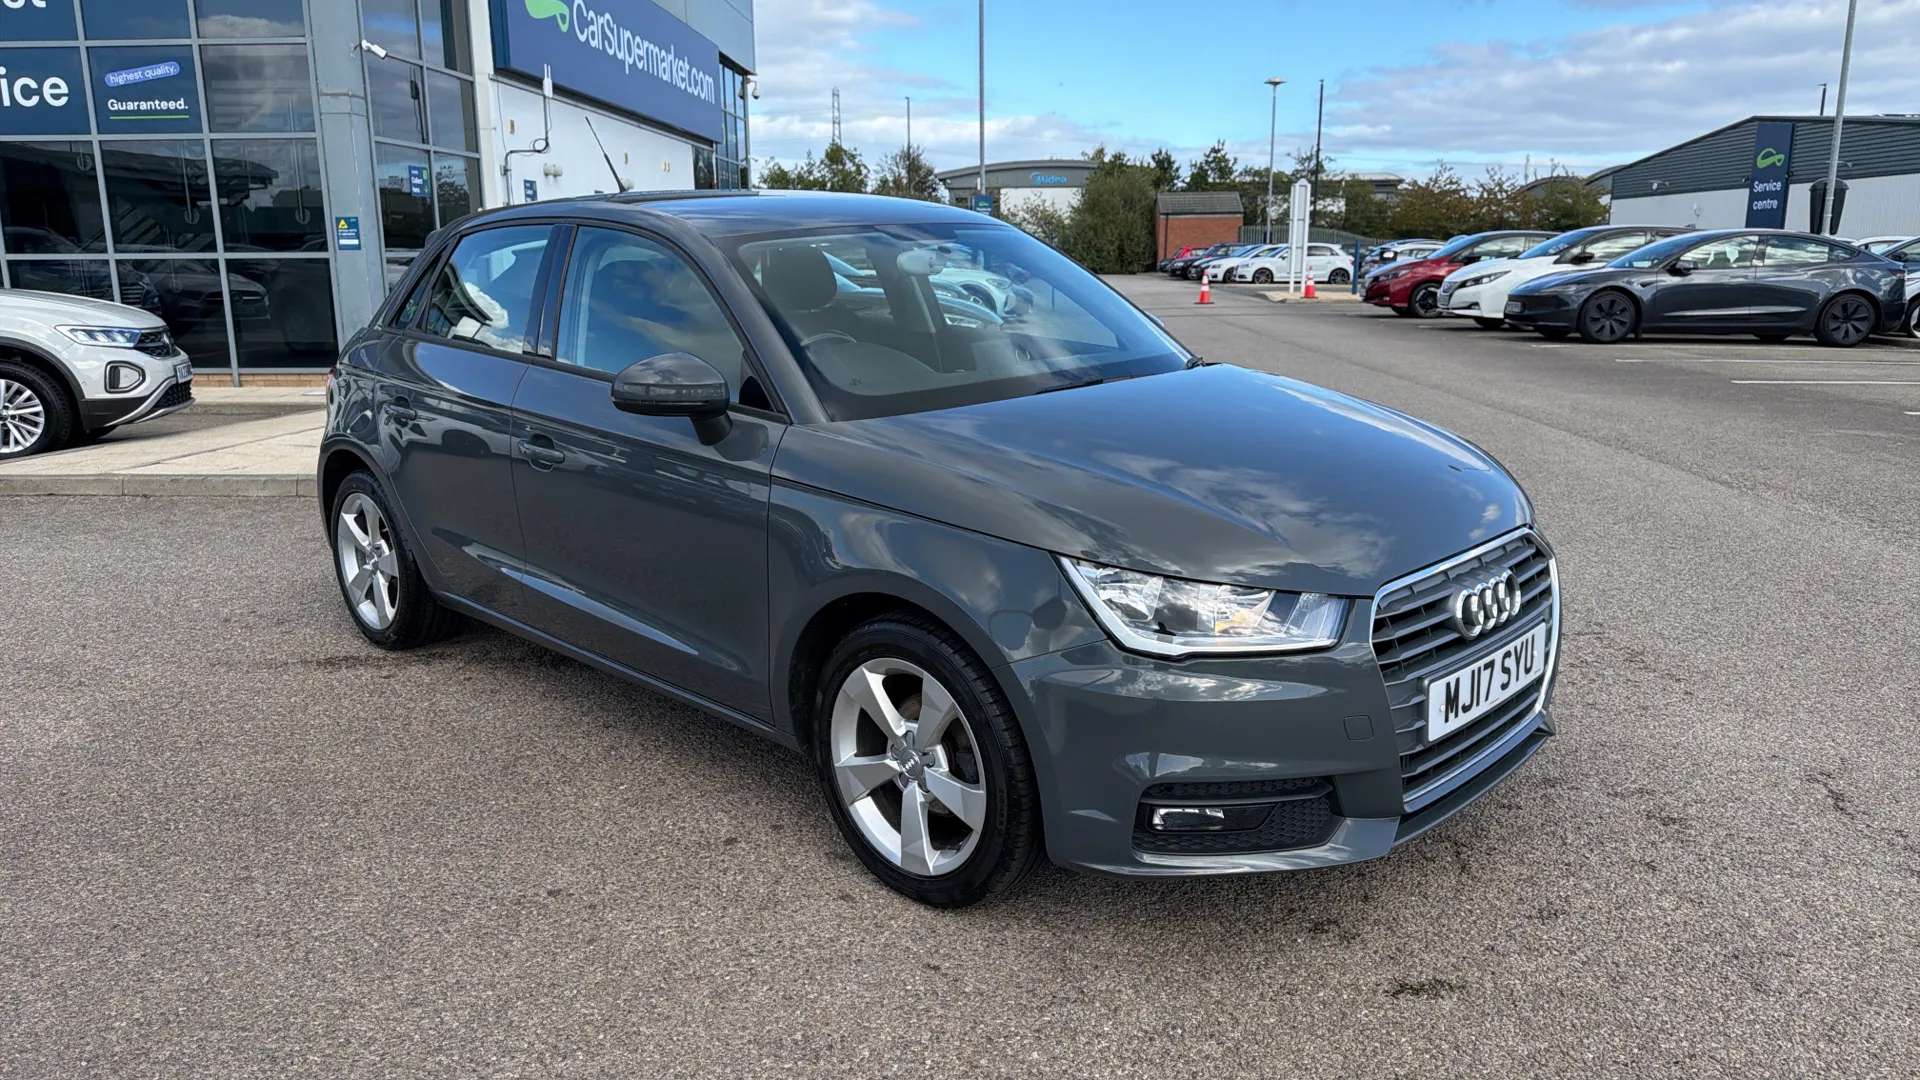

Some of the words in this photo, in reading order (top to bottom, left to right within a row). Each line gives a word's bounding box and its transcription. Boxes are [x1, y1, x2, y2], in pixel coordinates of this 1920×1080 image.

[573, 0, 715, 104] CarSupermarket.com
[110, 71, 143, 85] highest
[144, 64, 177, 79] quality.
[107, 97, 188, 111] Guaranteed.
[1753, 180, 1782, 192] Service
[1752, 198, 1778, 210] centre
[1444, 659, 1495, 723] MJ17
[1500, 634, 1535, 691] SYU
